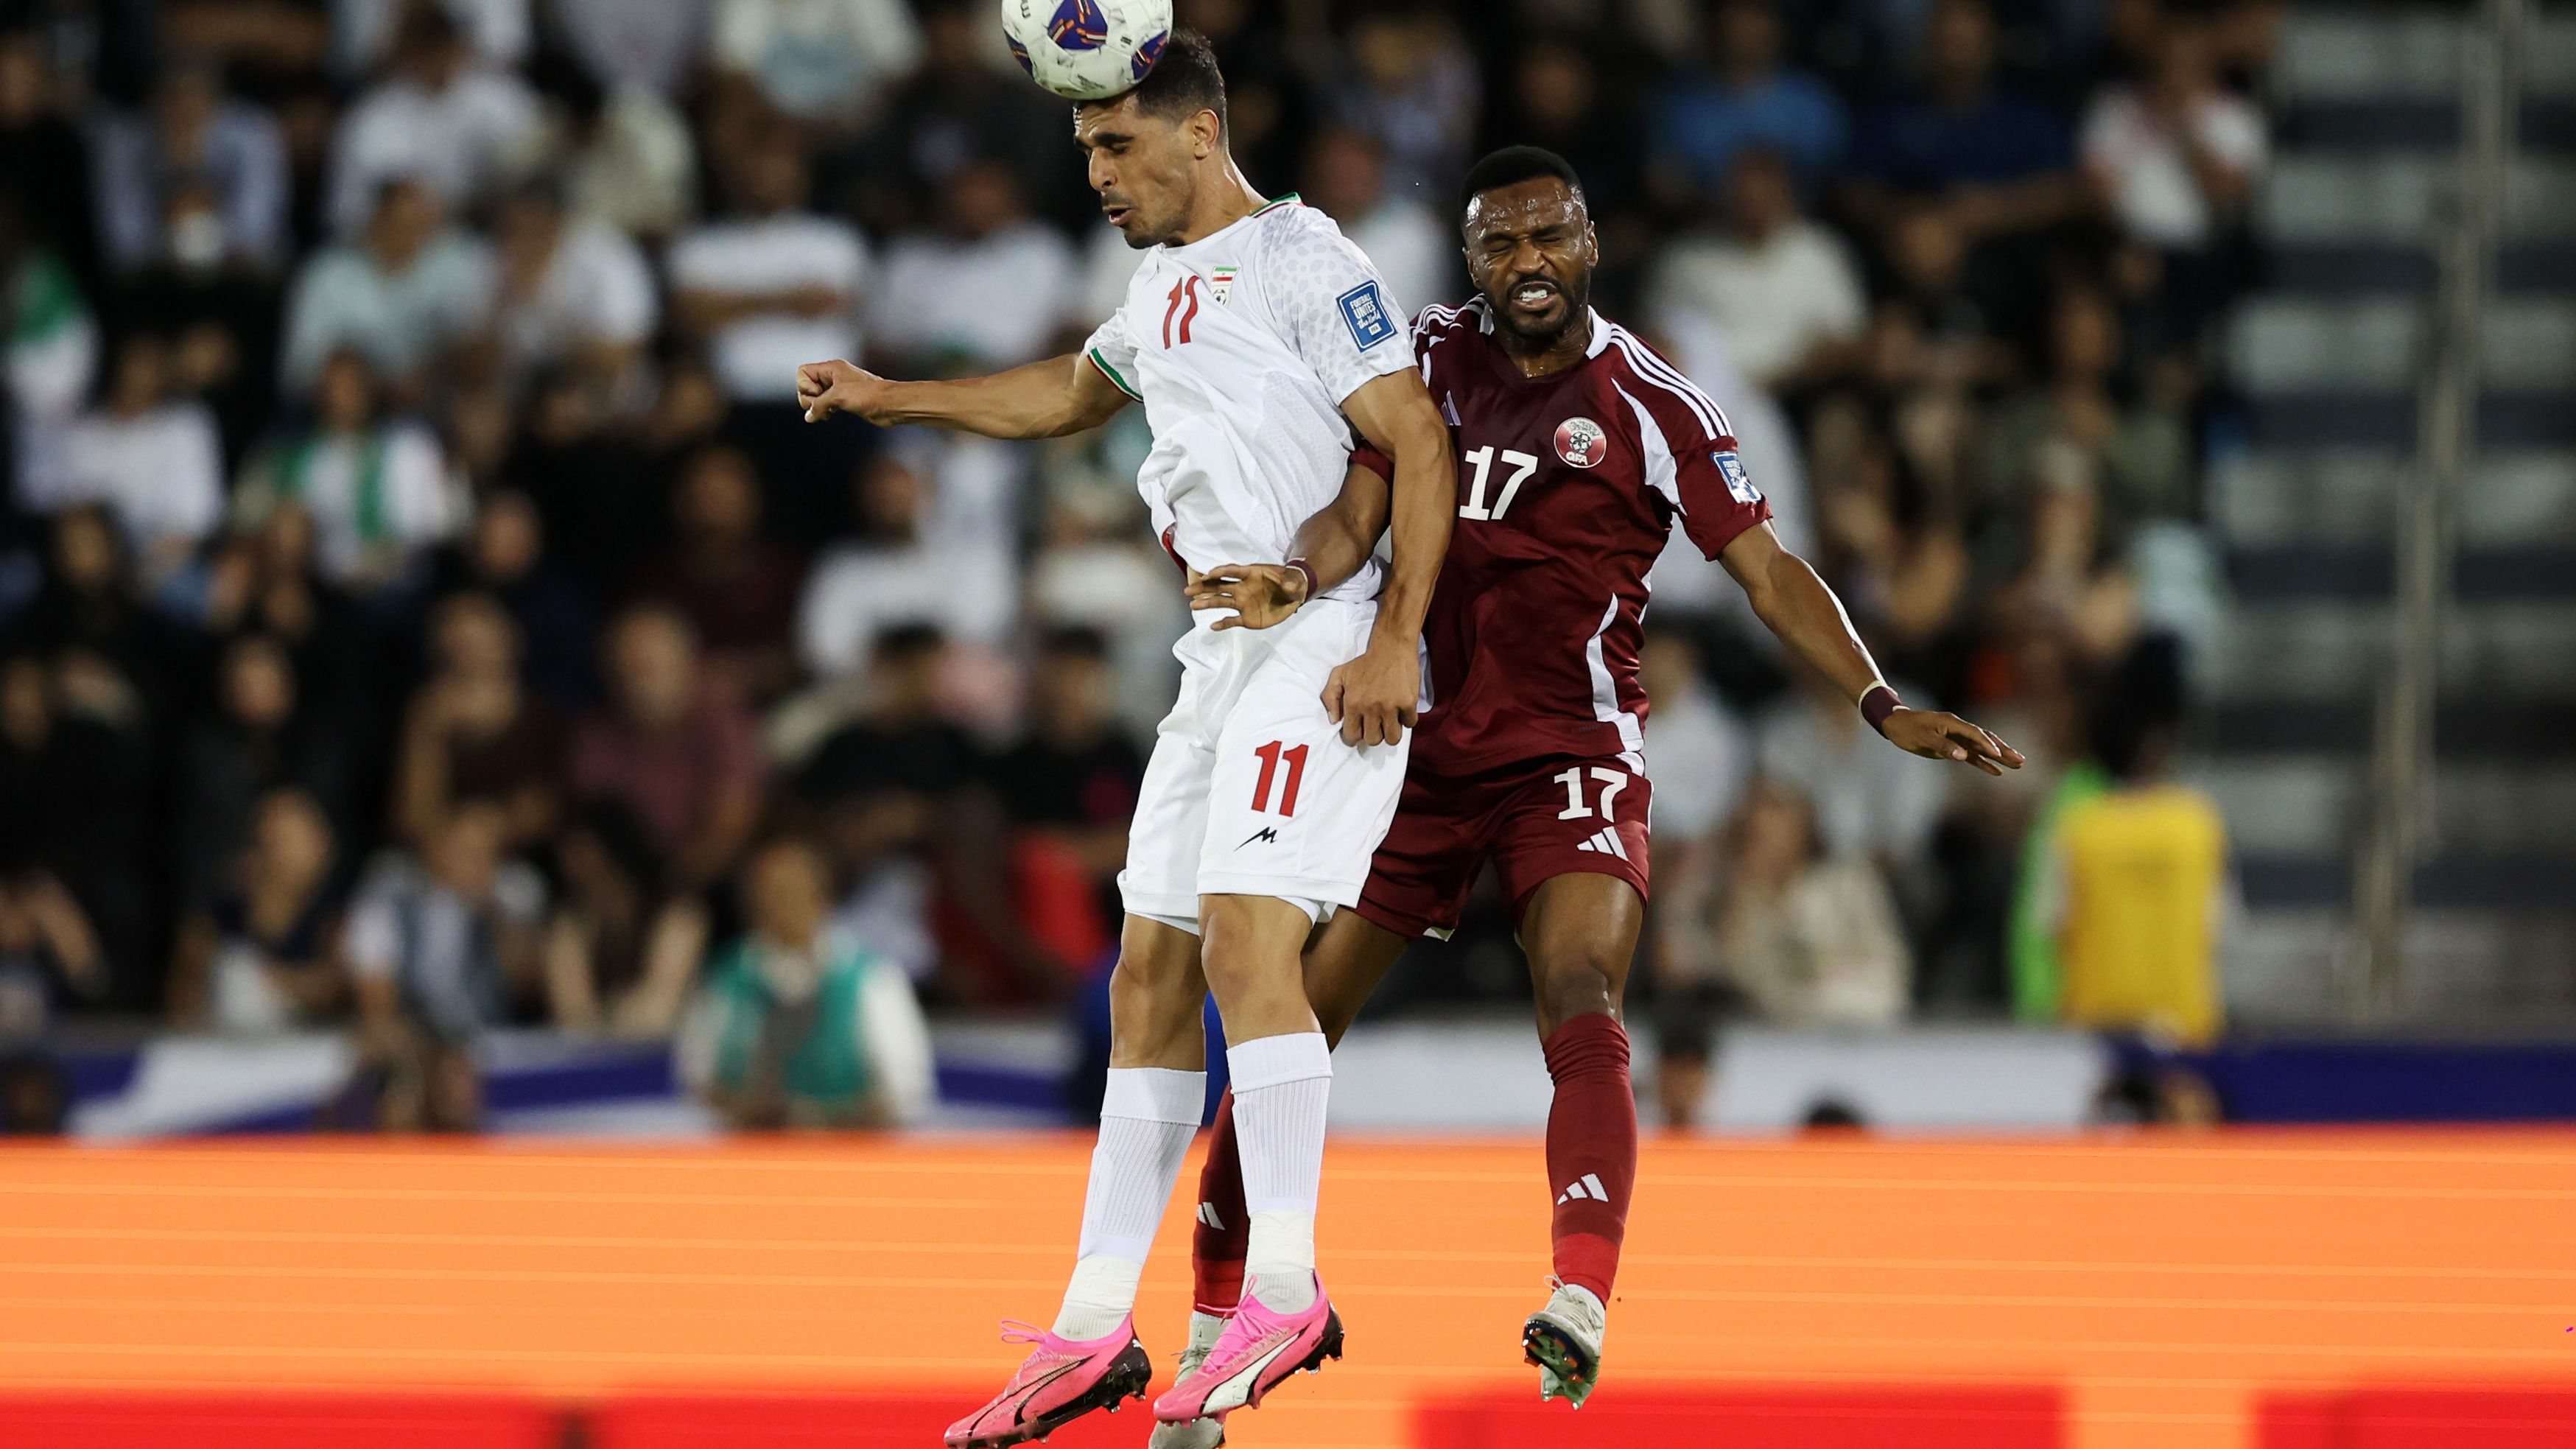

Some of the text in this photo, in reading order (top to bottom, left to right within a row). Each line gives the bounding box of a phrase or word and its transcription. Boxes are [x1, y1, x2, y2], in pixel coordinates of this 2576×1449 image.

[1163, 268, 1201, 350] 11
[1353, 301, 1376, 319] UNITES
[1459, 446, 1538, 521] 17
[1565, 451, 1588, 466] QFA
[1252, 740, 1309, 817] 11
[1554, 767, 1627, 823] 17
